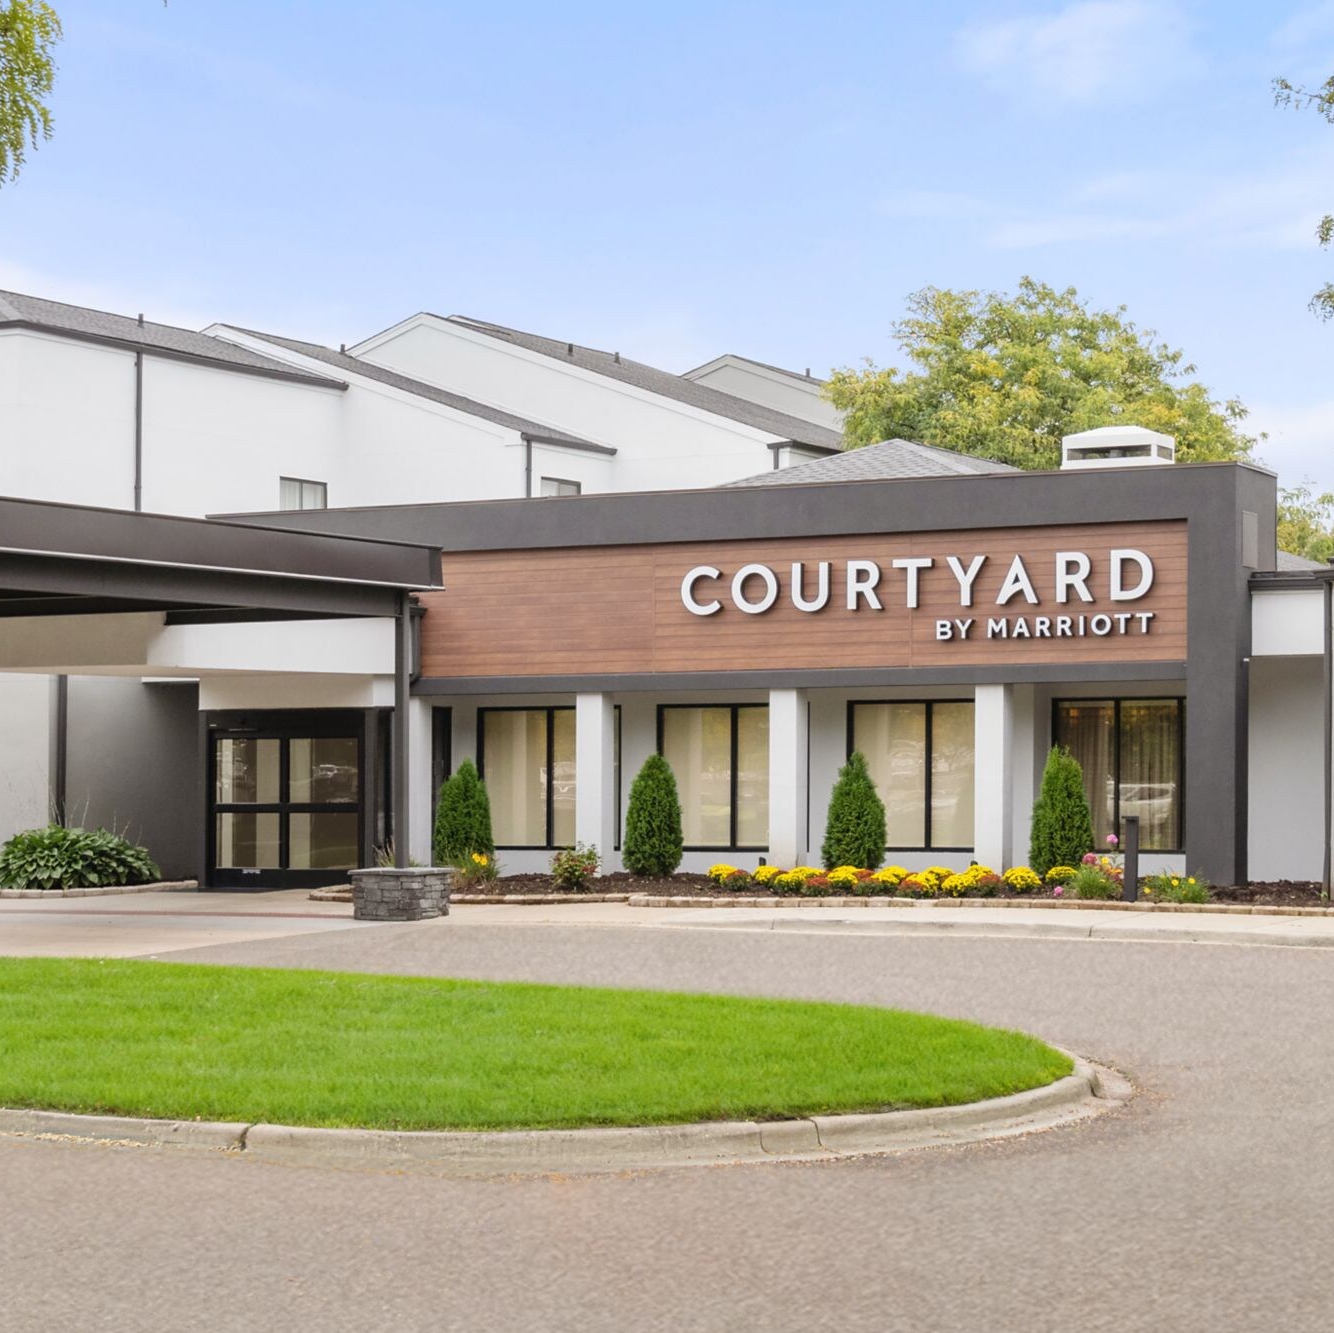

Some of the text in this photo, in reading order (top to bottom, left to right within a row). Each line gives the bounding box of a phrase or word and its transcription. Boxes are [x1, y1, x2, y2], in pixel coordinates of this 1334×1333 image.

[680, 548, 1154, 616] COURTYARD
[935, 612, 1154, 640] BY MARRIOTT
